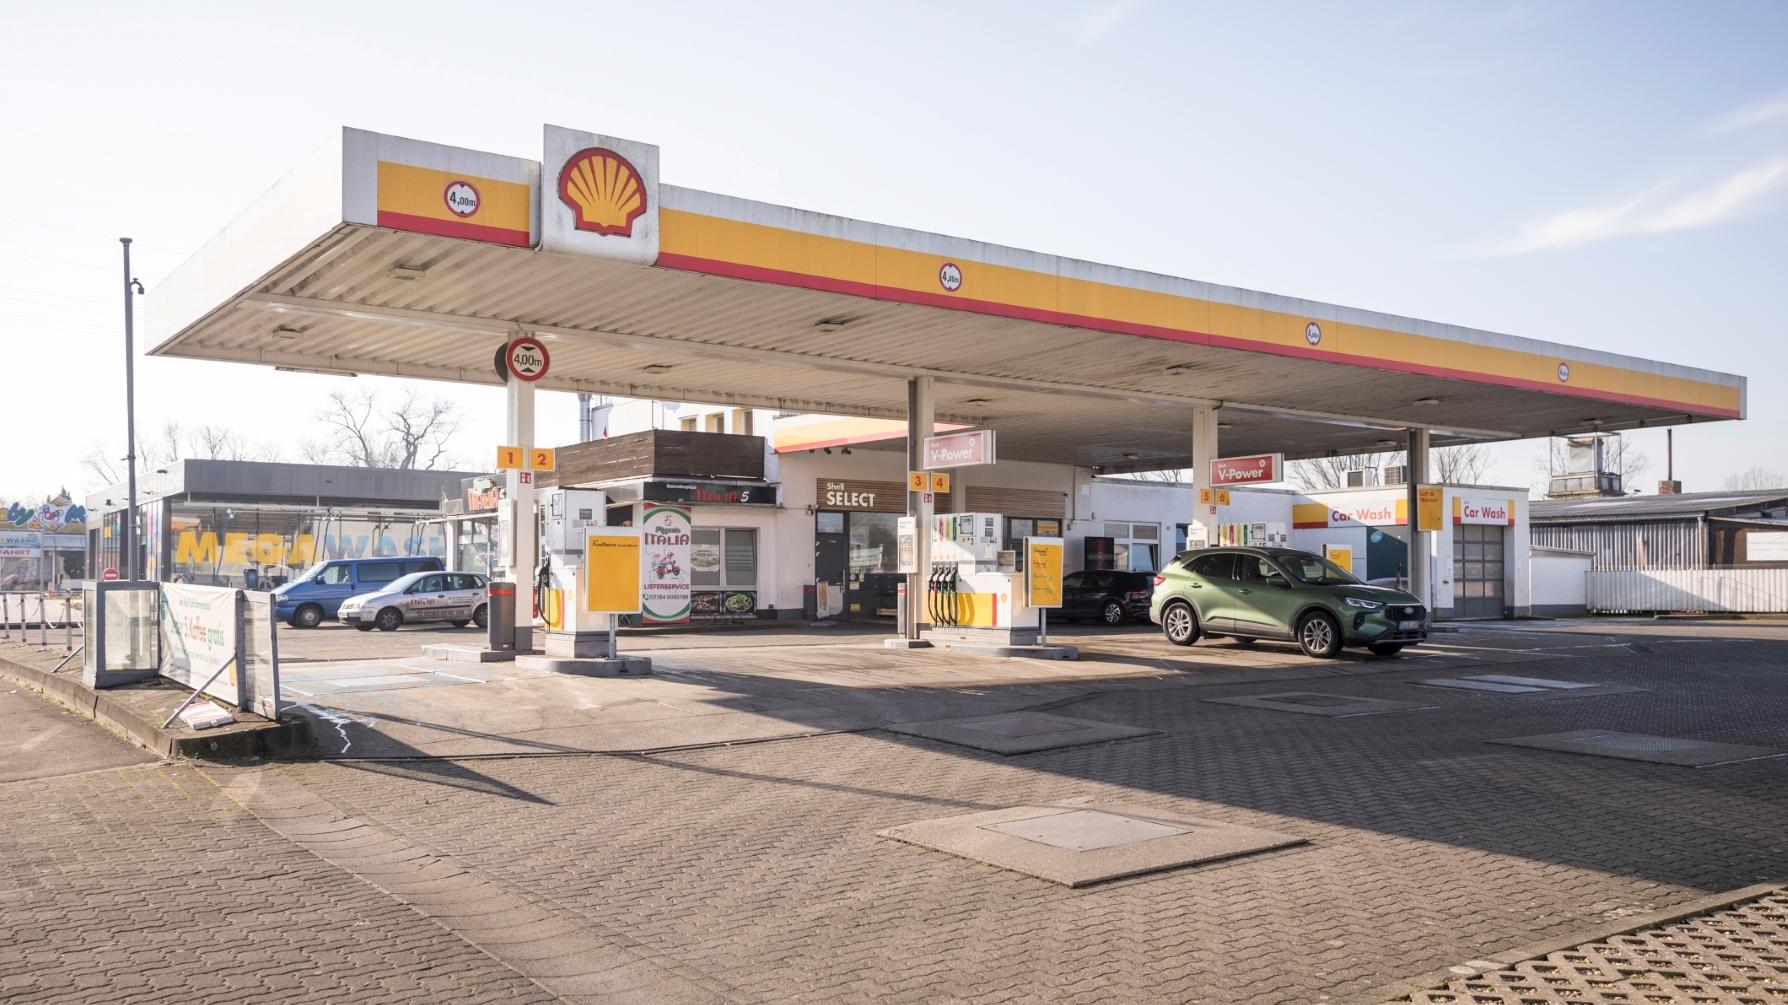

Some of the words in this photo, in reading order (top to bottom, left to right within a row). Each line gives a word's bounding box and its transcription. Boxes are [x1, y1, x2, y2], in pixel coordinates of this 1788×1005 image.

[450, 191, 476, 206] 4,00m
[513, 354, 542, 367] 4,00m
[507, 452, 513, 464] 1
[537, 453, 546, 465] 2
[930, 448, 974, 462] V-Power
[1218, 469, 1263, 481] V-Power
[915, 476, 921, 487] 3
[936, 478, 943, 487] 4
[741, 491, 749, 502] 5
[826, 491, 875, 507] SELECT
[1204, 492, 1209, 501] 5
[1220, 493, 1225, 502] 6
[1332, 510, 1352, 522] Car
[1357, 507, 1391, 521] Wash
[1463, 506, 1479, 518] Car
[1481, 507, 1506, 519] Wash
[644, 533, 690, 546] ITALIA
[175, 531, 320, 565] MEGA
